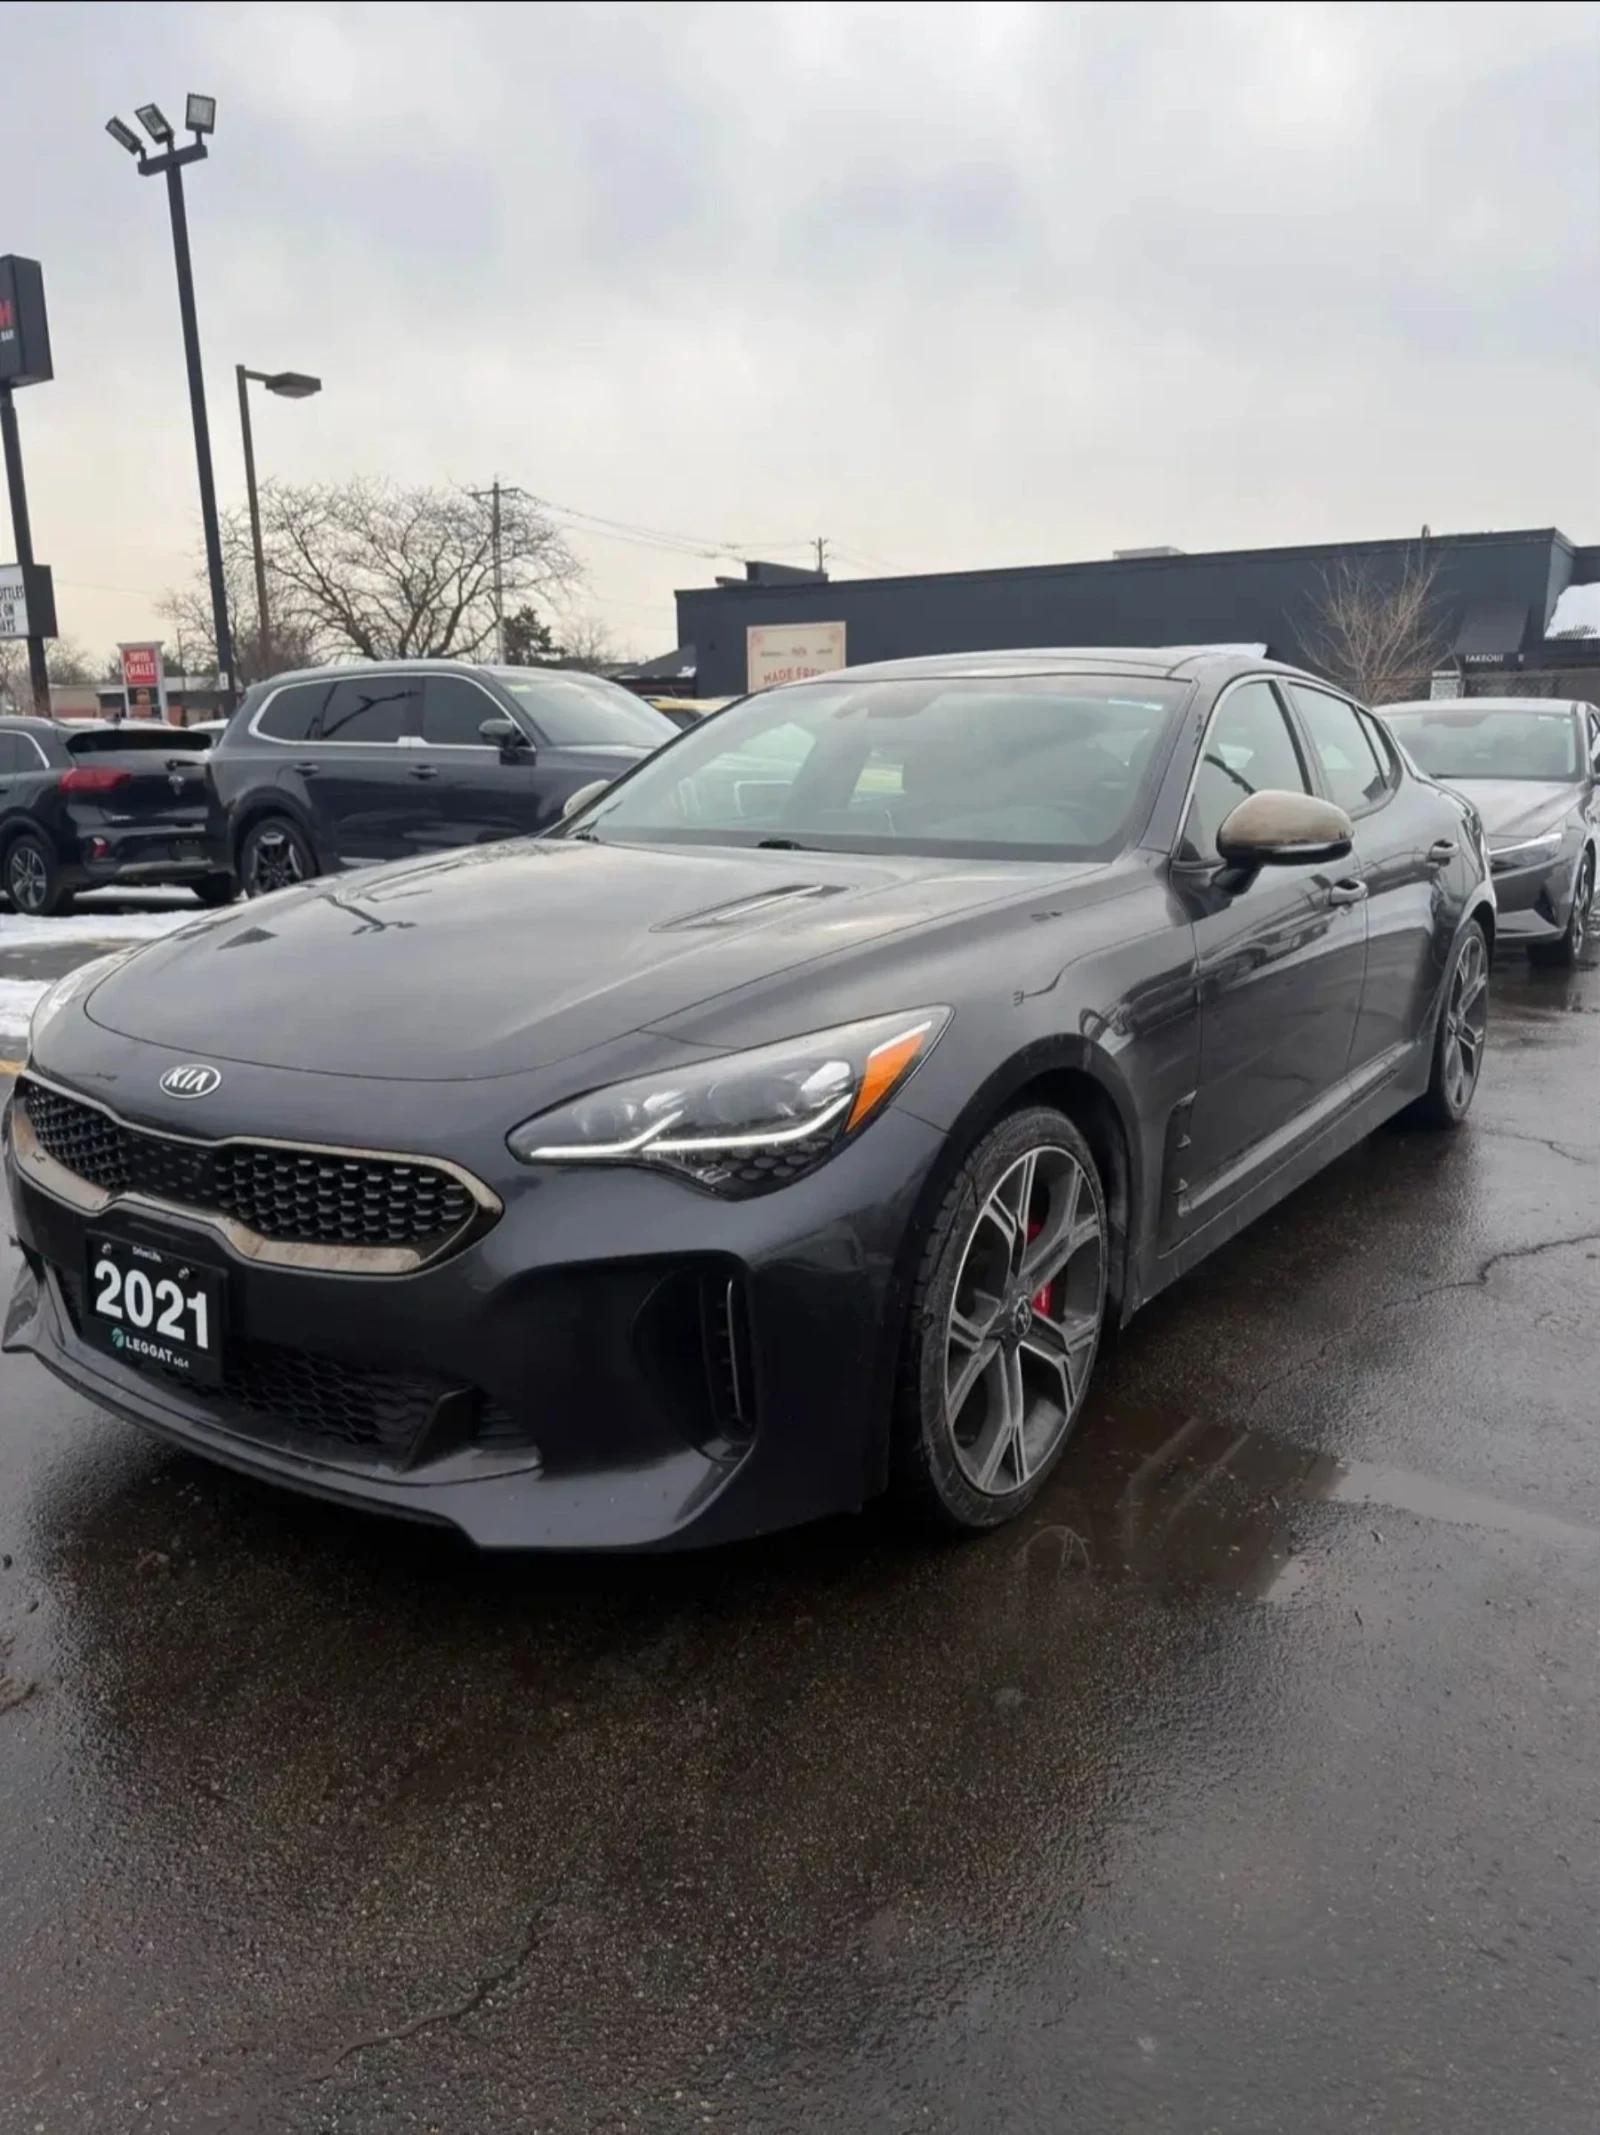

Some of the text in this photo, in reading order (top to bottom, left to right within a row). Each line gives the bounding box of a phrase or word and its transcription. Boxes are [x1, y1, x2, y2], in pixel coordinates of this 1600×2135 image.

[1465, 653, 1504, 662] TAKEOUT
[126, 661, 155, 682] CHALET
[763, 668, 793, 684] MADE
[164, 1067, 209, 1092] KIA
[94, 1259, 208, 1349] 2021
[125, 1335, 173, 1363] LEGGAT
